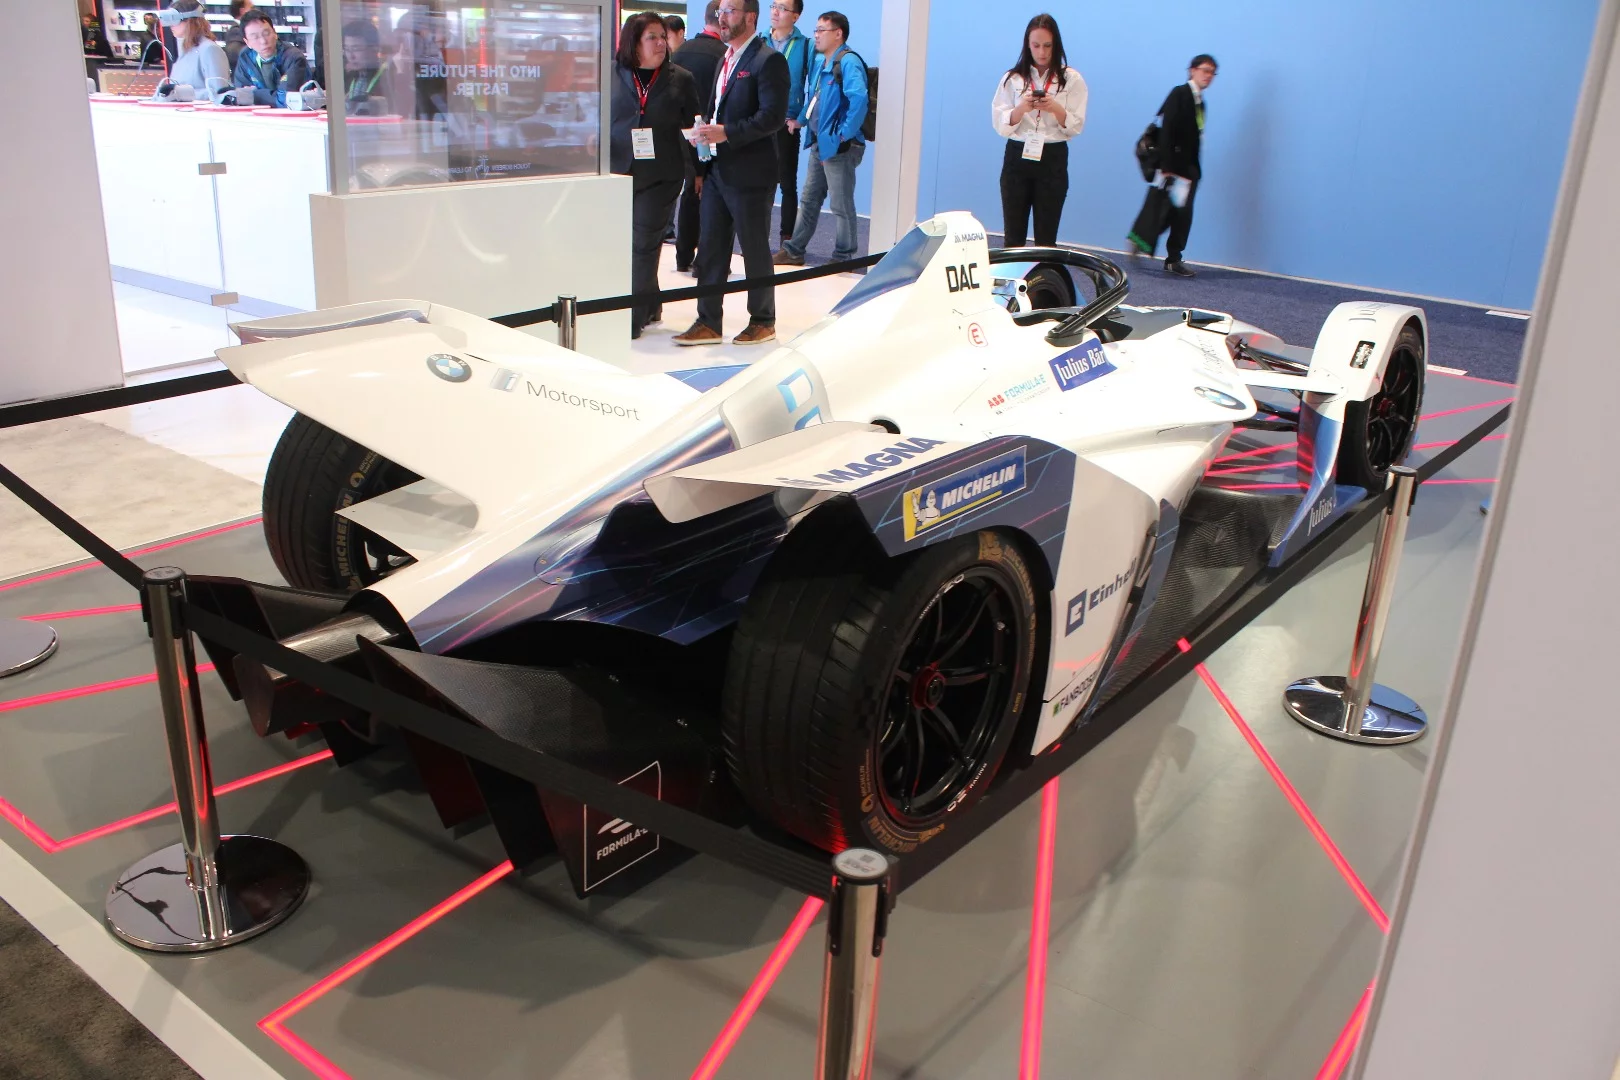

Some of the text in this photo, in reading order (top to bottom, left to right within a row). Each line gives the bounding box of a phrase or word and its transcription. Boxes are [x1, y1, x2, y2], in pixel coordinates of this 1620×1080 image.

[961, 232, 985, 242] MAGNA
[945, 262, 980, 293] DAC
[1054, 347, 1106, 386] Julius Bär
[526, 380, 640, 421] Motorsport
[987, 394, 1005, 409] ABB
[813, 437, 948, 484] MAGNA
[940, 464, 1017, 510] MICHELIN
[335, 493, 353, 577] MICHELN
